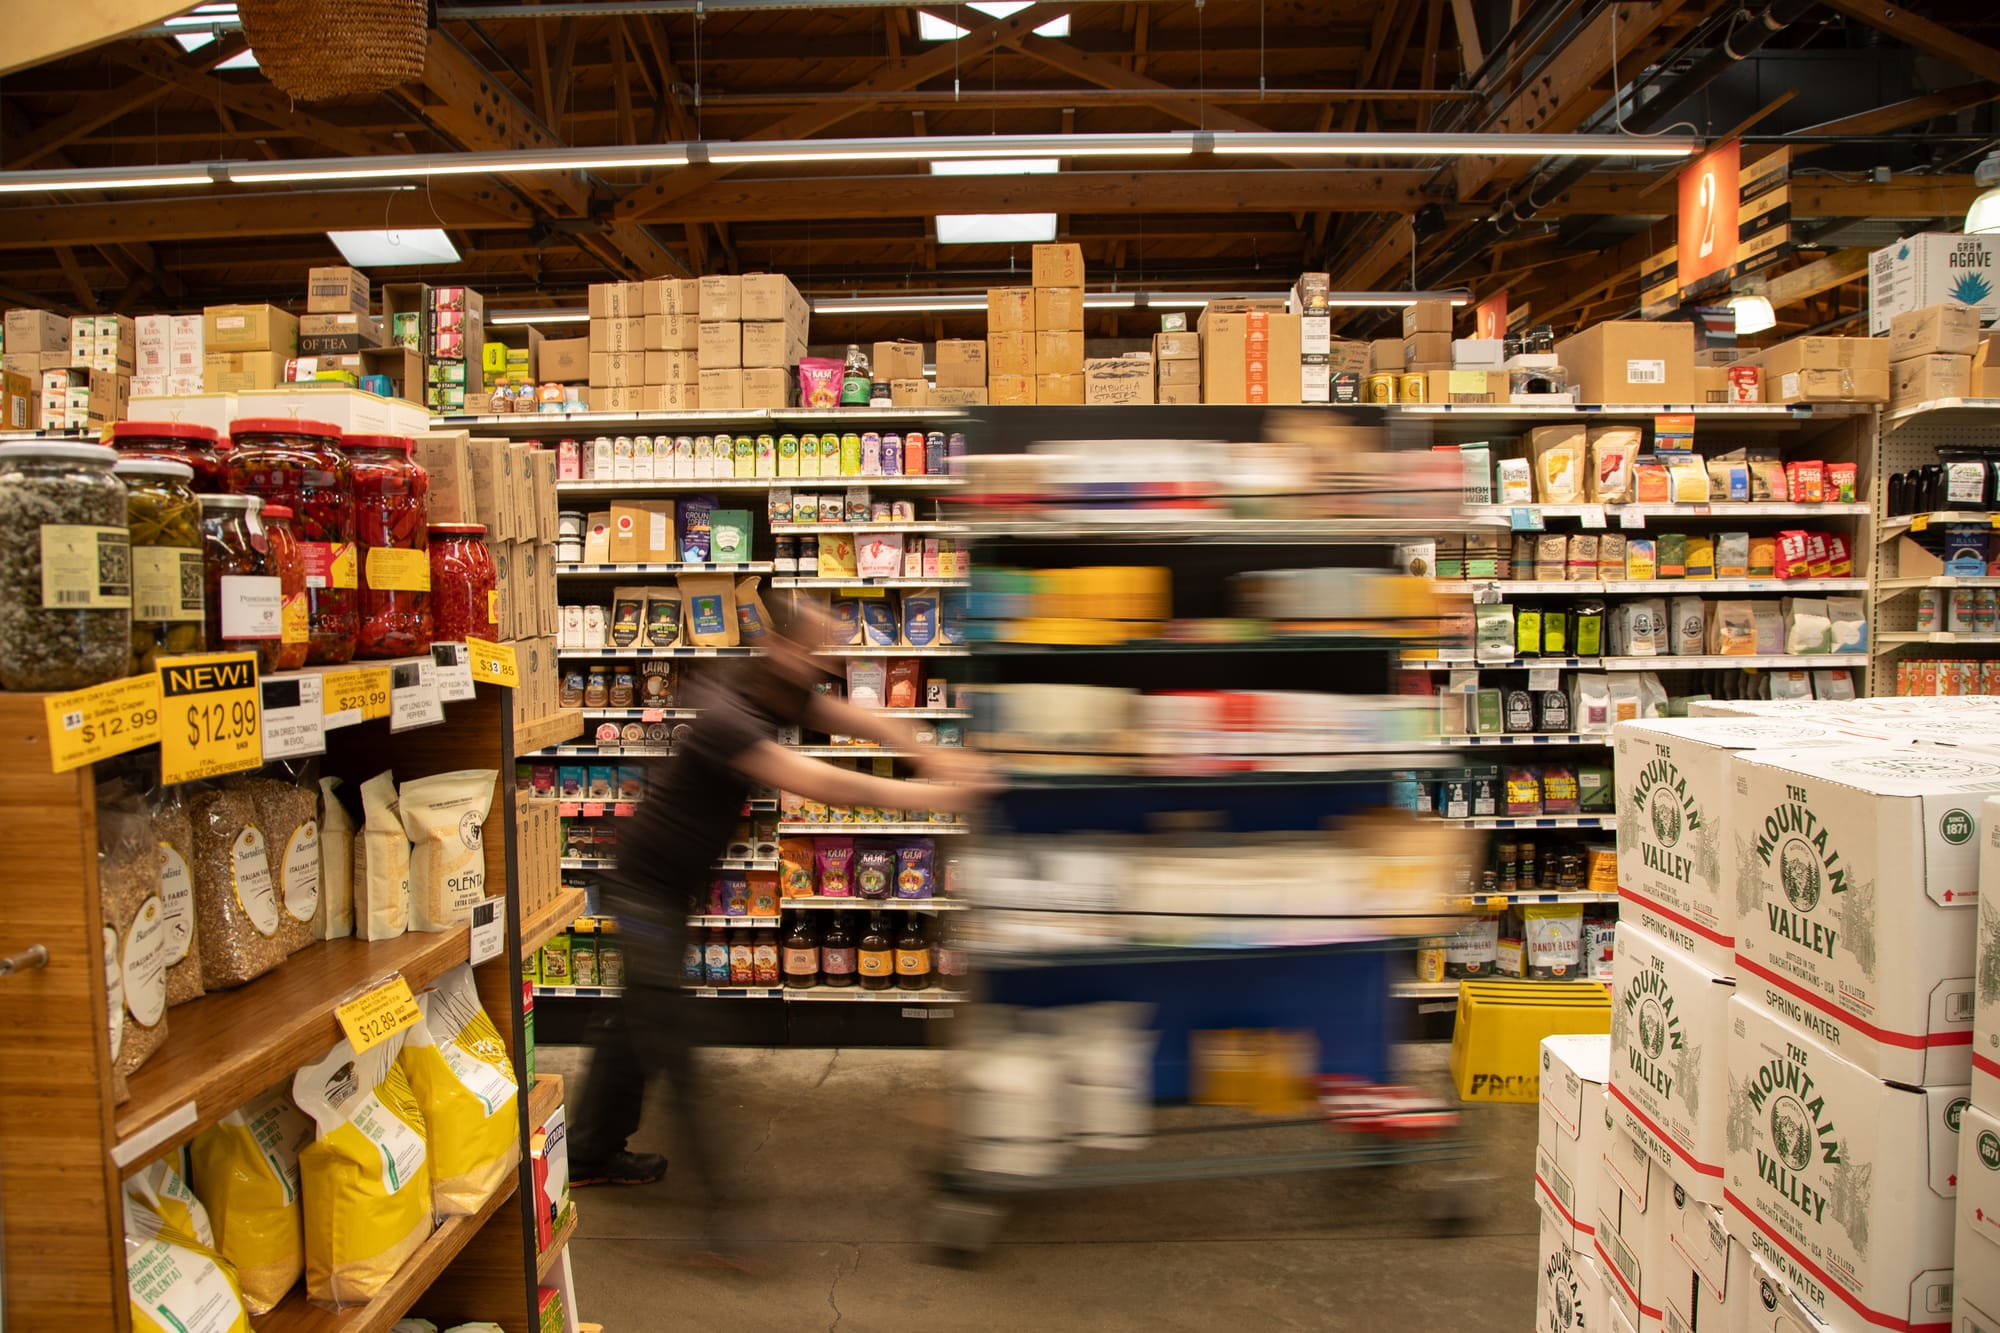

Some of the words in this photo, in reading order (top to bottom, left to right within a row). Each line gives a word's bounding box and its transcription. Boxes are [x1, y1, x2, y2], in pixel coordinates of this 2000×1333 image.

[1698, 172, 1716, 259] 2
[1957, 242, 1982, 252] GRAN
[1949, 251, 1993, 268] AGAVE
[302, 339, 319, 350] OF
[323, 337, 348, 350] TEA
[1090, 381, 1141, 394] KOMBUCHA
[1464, 486, 1489, 494] HIGH
[169, 664, 248, 692] NEW!
[642, 661, 670, 675] LAIRD
[339, 691, 386, 711] $23.99
[82, 708, 157, 743] $12.99
[187, 699, 256, 750] $12.99
[1655, 743, 1671, 758] THE
[1633, 758, 1701, 832] MOUNTAIN
[1786, 784, 1807, 803] THE
[1946, 823, 1968, 835] 1871
[239, 846, 266, 860] Bartolin
[1757, 803, 1849, 895] MOUNTAIN
[161, 866, 182, 880] olini
[289, 863, 310, 873] ITALIAN
[1641, 841, 1692, 884] VALLEY
[240, 872, 260, 882] ITALIAN
[167, 889, 189, 902] FARRO
[1595, 929, 1615, 943] LAI
[1641, 913, 1668, 938] SPRING
[1668, 926, 1695, 953] WATER
[1767, 902, 1836, 960] VALLEY
[1532, 941, 1557, 953] DANDY
[1651, 955, 1665, 974] THE
[1792, 964, 1820, 988] MOUNTAINS
[1824, 979, 1835, 995] USA
[1850, 985, 1866, 1000] LITER
[1624, 969, 1683, 1050] MOUNTAIN
[1765, 989, 1802, 1023] SPRING
[1803, 1009, 1841, 1046] WATER
[359, 1011, 396, 1043] $12.89
[1786, 1042, 1807, 1067] THE
[1629, 1044, 1672, 1100] VALLEY
[1748, 1059, 1841, 1165] MOUNTAIN
[1950, 1112, 1961, 1124] 18
[1626, 1113, 1648, 1145] SPRING
[1648, 1135, 1672, 1168] WATER
[1981, 1143, 2000, 1163] 1871
[1755, 1147, 1827, 1226] VALLEY
[1779, 1215, 1807, 1248] MOUNTAINS
[1811, 1240, 1823, 1260] USA
[1561, 1241, 1572, 1261] THE
[131, 1270, 156, 1295] CORN
[152, 1254, 176, 1277] GRITS
[1751, 1231, 1787, 1273] SPRING
[1788, 1262, 1825, 1310] WATER
[1839, 1256, 1856, 1275] LITER
[141, 1265, 183, 1305] (POLENTA)
[1546, 1251, 1585, 1329] MOUNTAIN
